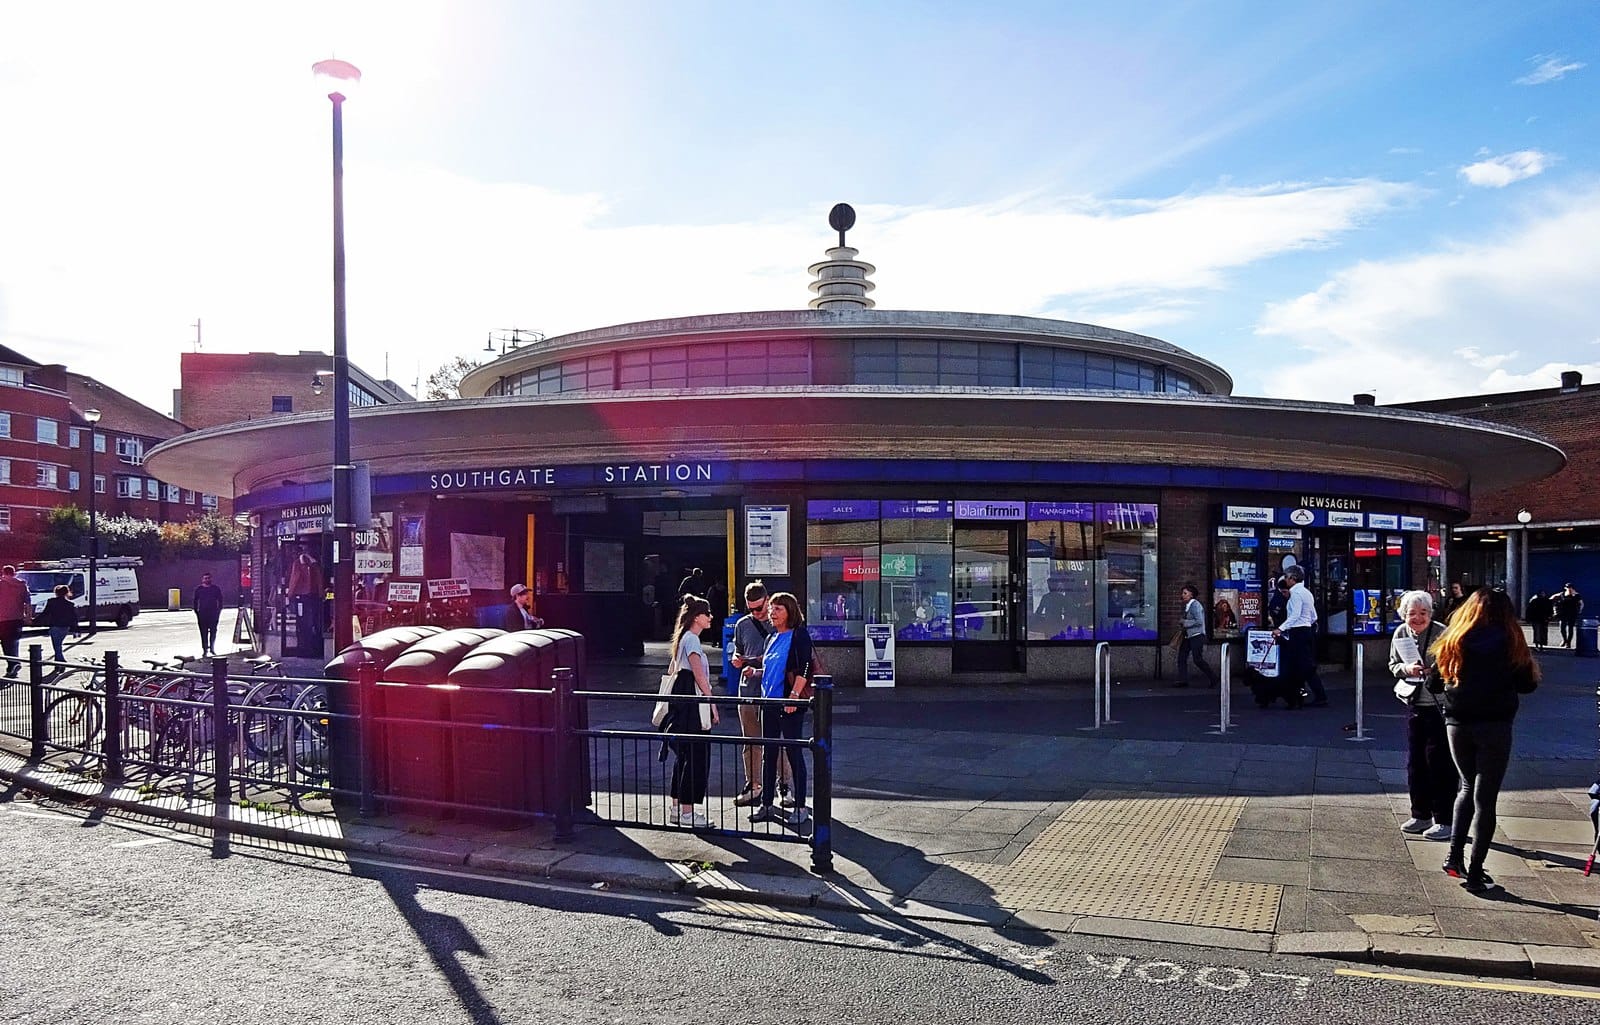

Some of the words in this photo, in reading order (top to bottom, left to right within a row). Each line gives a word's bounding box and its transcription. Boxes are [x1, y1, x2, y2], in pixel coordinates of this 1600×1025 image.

[431, 469, 555, 490] SOUTHGATE
[605, 464, 712, 482] STATION
[1301, 496, 1362, 510] NEWSAGENT
[281, 507, 298, 518] MENS
[300, 503, 332, 516] FASHION
[959, 504, 1020, 517] blainfirmin
[1231, 510, 1268, 520] Lycamobile
[297, 520, 315, 530] ROUTE
[1331, 515, 1359, 524] Lycamobile
[355, 532, 379, 545] SUITS
[1087, 954, 1312, 1000] LOOK
